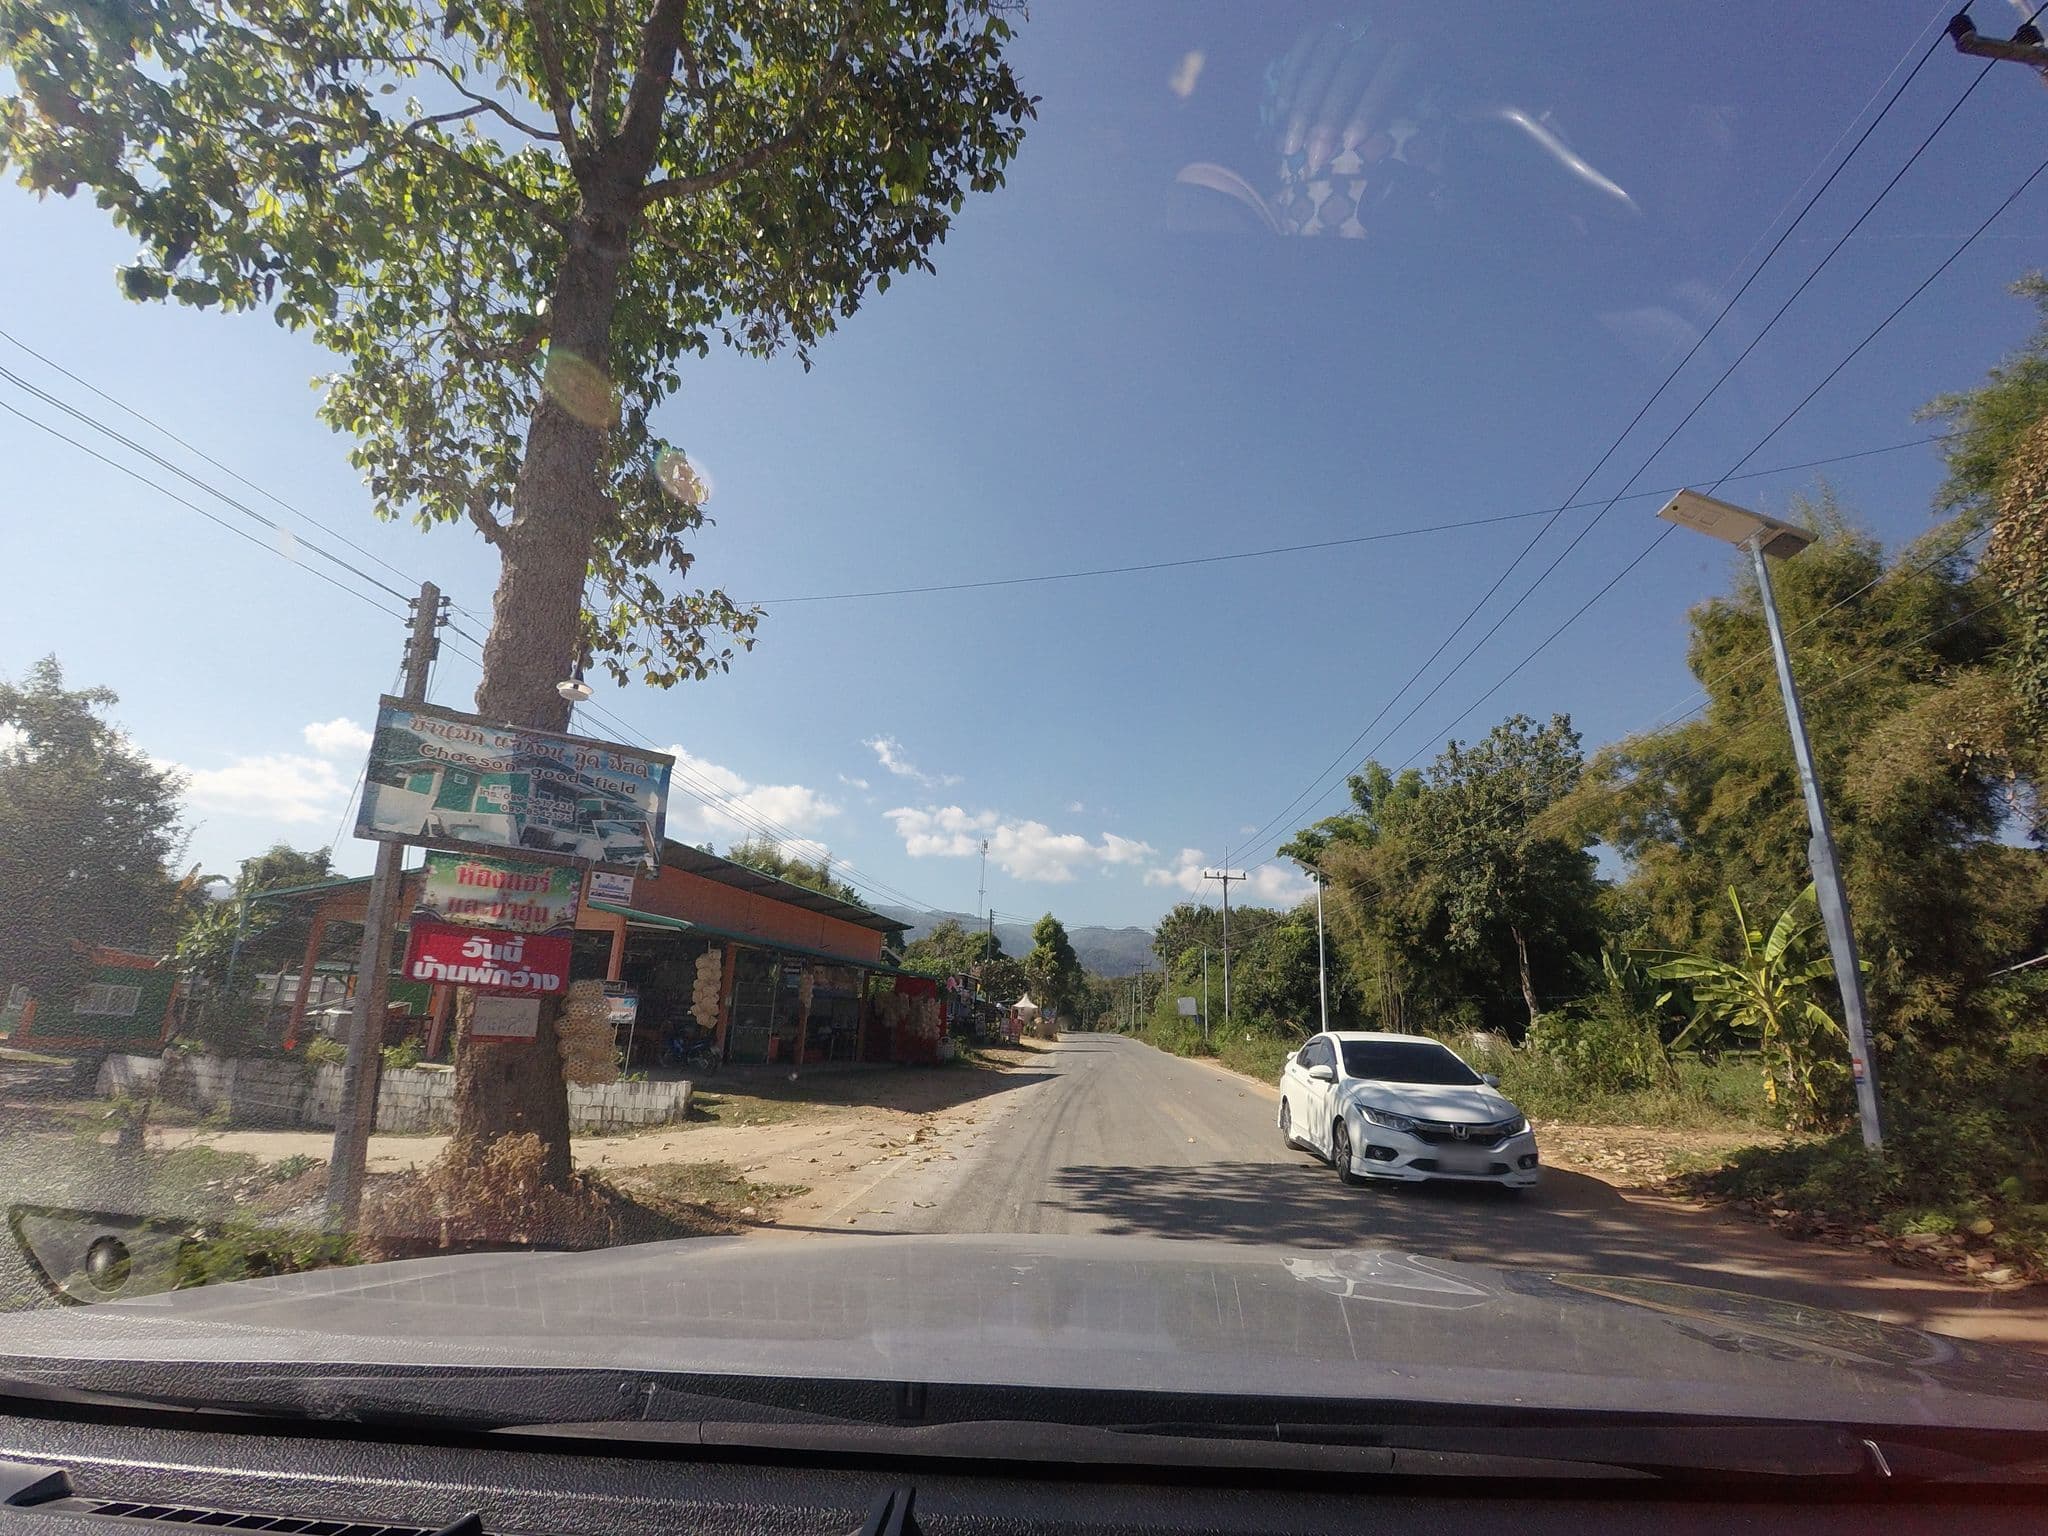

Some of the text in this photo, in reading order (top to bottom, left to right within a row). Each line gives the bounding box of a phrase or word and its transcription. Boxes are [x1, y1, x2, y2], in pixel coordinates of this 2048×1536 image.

[419, 744, 637, 795] Chaeson good field
[457, 860, 551, 892] ห้องแอร์
[461, 935, 526, 963] วันนี้
[412, 955, 560, 991] บ้านพักว่าง
